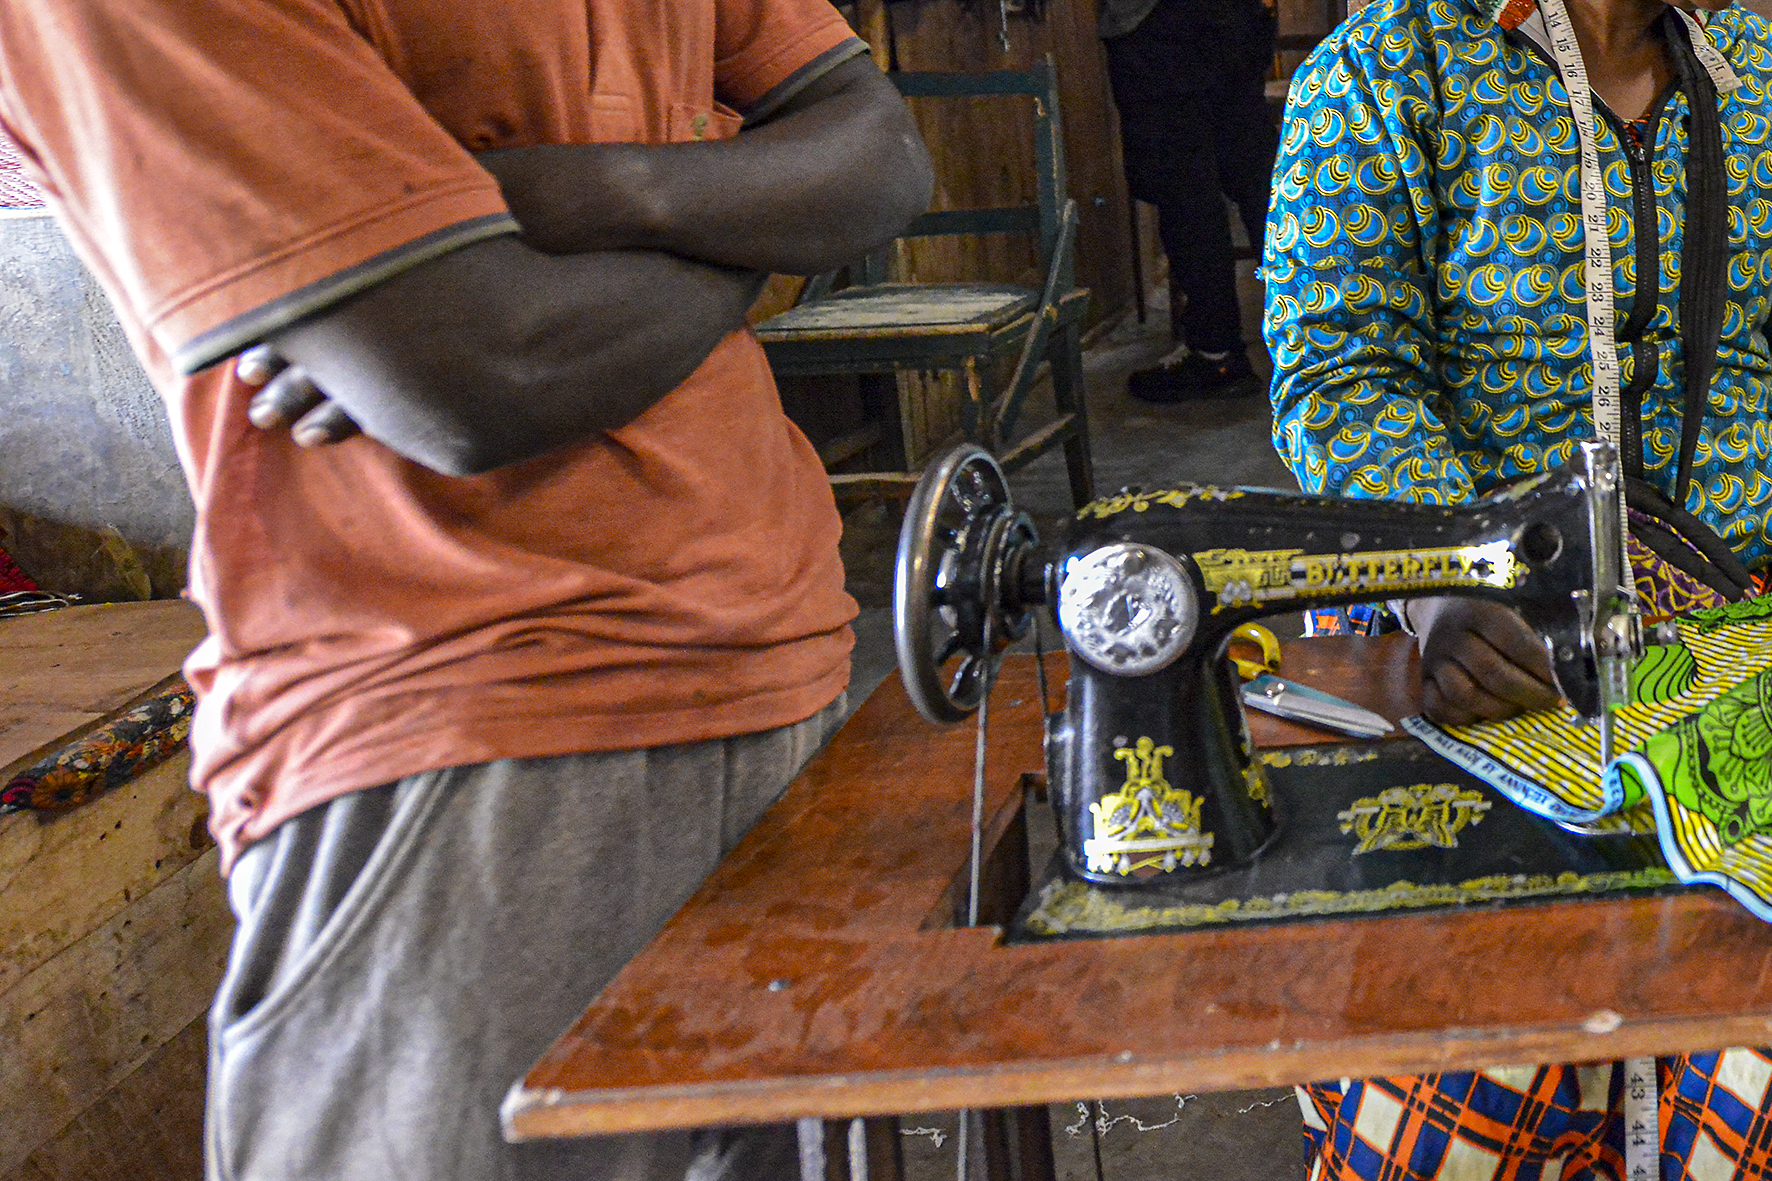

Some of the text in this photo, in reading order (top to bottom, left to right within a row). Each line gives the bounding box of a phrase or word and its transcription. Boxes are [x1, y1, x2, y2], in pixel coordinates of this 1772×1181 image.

[1548, 10, 1562, 29] 14
[1556, 37, 1571, 53] 15
[1563, 62, 1578, 78] 16
[1571, 89, 1585, 106] 17
[1584, 180, 1597, 201] 20
[1588, 213, 1600, 233] 21
[1589, 247, 1602, 268] 22
[1591, 281, 1604, 303] 23
[1593, 315, 1605, 337] 24
[1596, 350, 1610, 372] 25
[1598, 385, 1611, 407] 26
[1306, 554, 1473, 585] BUTTERFLY
[1630, 1072, 1647, 1100] 43
